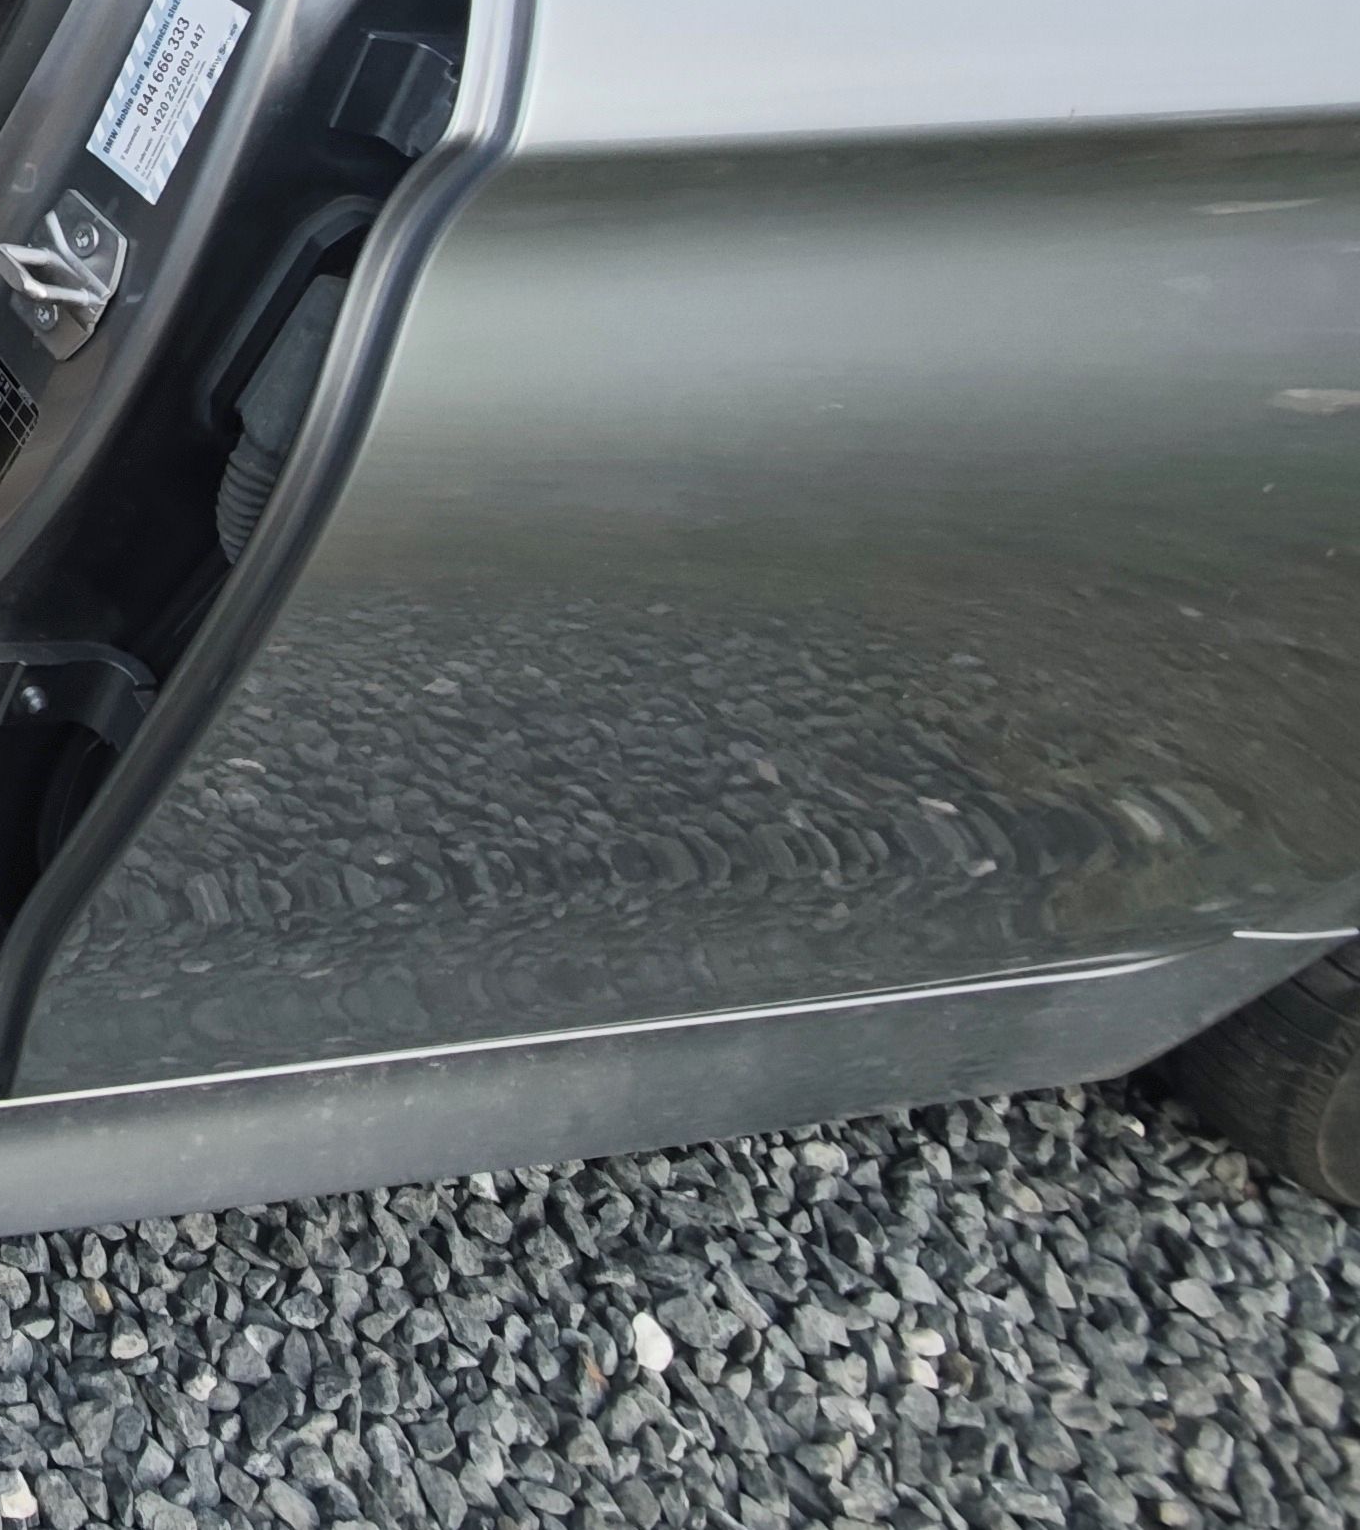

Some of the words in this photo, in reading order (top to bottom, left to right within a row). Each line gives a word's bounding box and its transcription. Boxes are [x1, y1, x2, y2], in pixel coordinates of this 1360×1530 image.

[103, 129, 118, 154] BMW
[117, 96, 134, 129] Mobile
[131, 74, 145, 96] Care
[137, 83, 158, 117] 844
[153, 50, 174, 83] 666
[168, 16, 190, 51] 333
[151, 101, 169, 133] +420
[165, 76, 182, 102] 222
[177, 50, 194, 76] 803
[190, 23, 207, 51] 447
